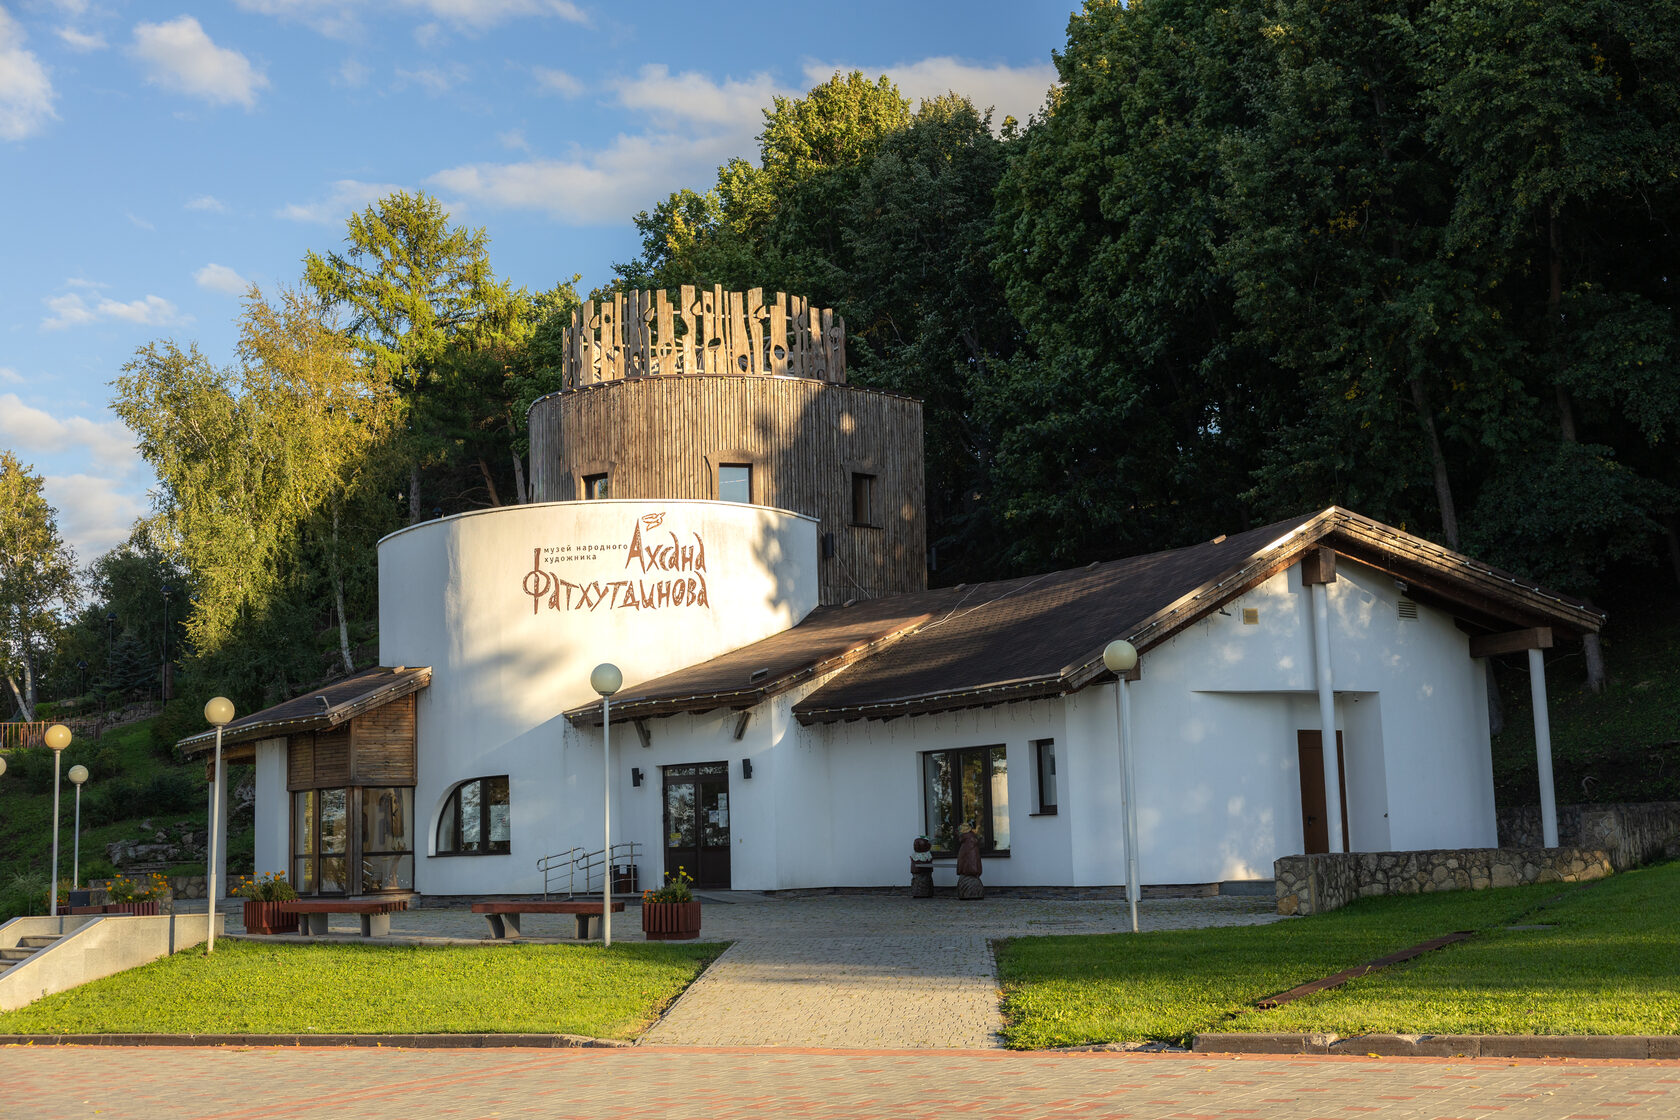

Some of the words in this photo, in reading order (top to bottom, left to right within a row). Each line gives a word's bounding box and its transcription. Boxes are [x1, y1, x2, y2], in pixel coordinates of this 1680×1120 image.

[543, 544, 572, 554] музей
[576, 543, 628, 553] народного
[625, 518, 707, 574] Ахсана
[544, 554, 597, 563] художника
